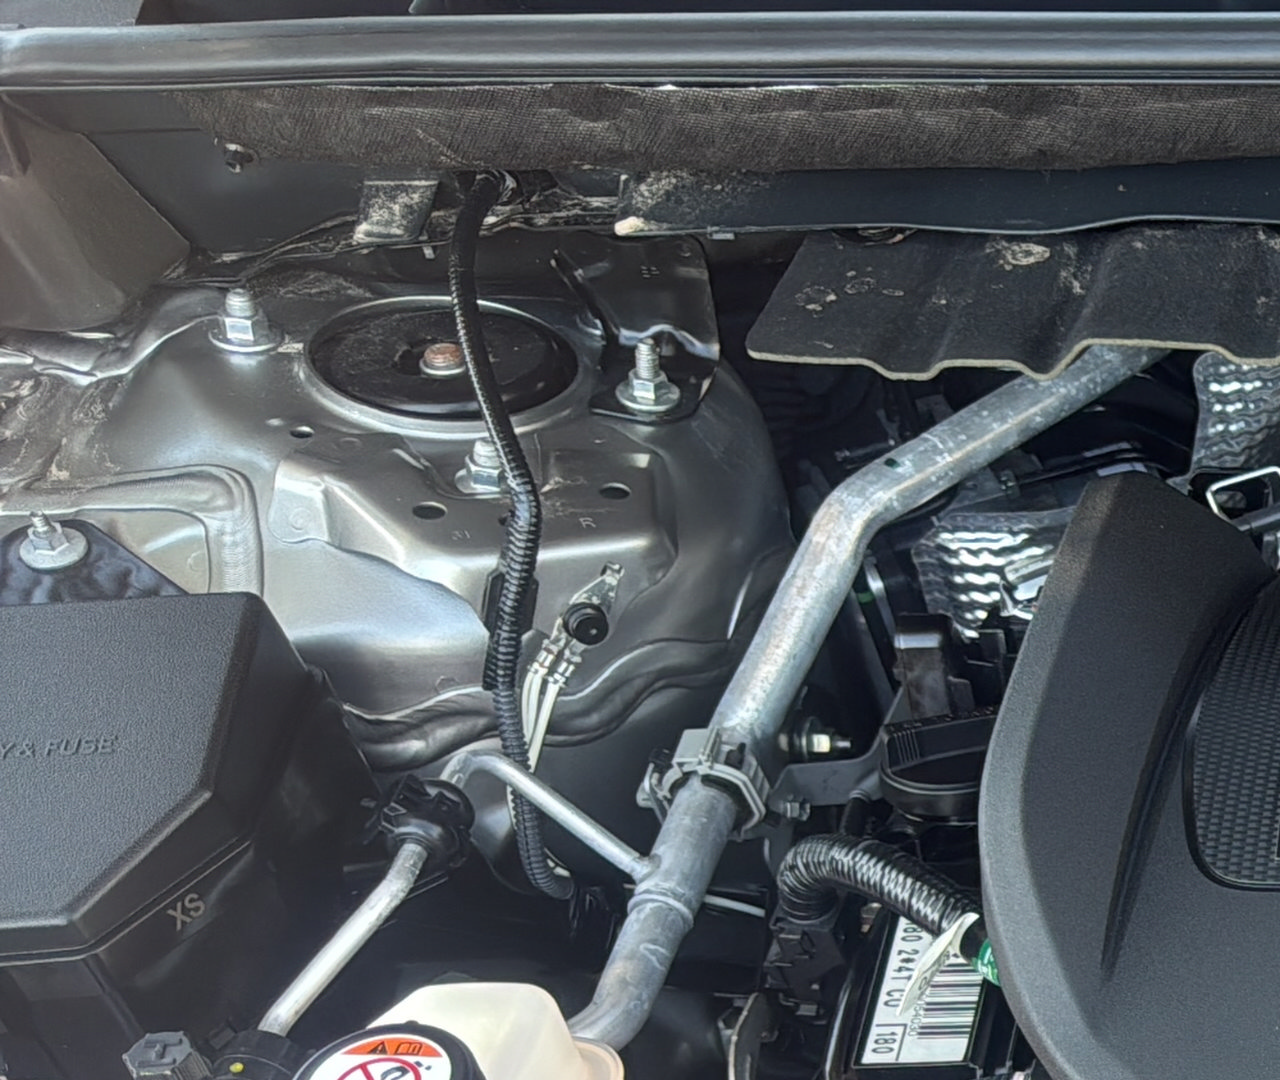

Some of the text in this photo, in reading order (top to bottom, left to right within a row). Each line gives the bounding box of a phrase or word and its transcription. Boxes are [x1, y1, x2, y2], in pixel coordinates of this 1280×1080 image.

[44, 733, 119, 757] FUSE
[166, 893, 205, 931] XS
[871, 1031, 898, 1055] 180
